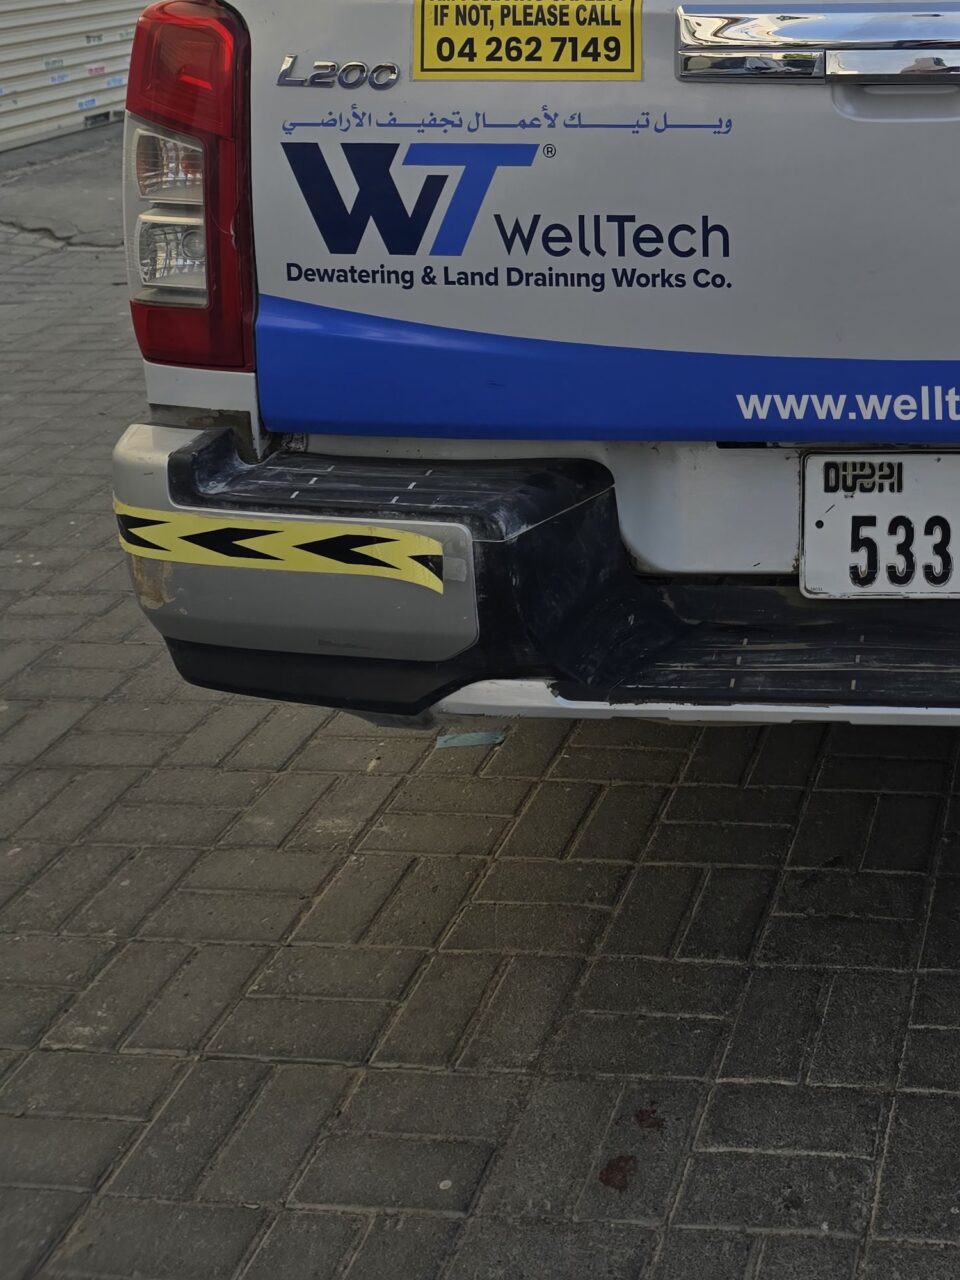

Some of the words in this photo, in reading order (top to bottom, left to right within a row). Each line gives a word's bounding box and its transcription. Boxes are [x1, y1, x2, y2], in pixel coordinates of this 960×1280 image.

[433, 5, 449, 26] IF
[455, 5, 495, 31] NOT,
[501, 4, 570, 26] PLEASE
[575, 4, 622, 26] CALL
[436, 36, 477, 62] 04
[485, 36, 543, 62] 262
[550, 36, 621, 62] 7149
[276, 54, 400, 90] L200
[281, 103, 372, 136] الأراضي
[375, 109, 463, 135] تجفيف
[466, 104, 558, 135] لأعمال
[653, 111, 733, 135] ويل
[280, 141, 541, 257] WT
[493, 213, 731, 259] WellTech
[286, 262, 415, 290] Dewatering
[420, 267, 438, 286] &
[443, 266, 499, 288] Land
[506, 267, 605, 292] Draining
[611, 268, 687, 290] Works
[692, 269, 733, 290] Co.
